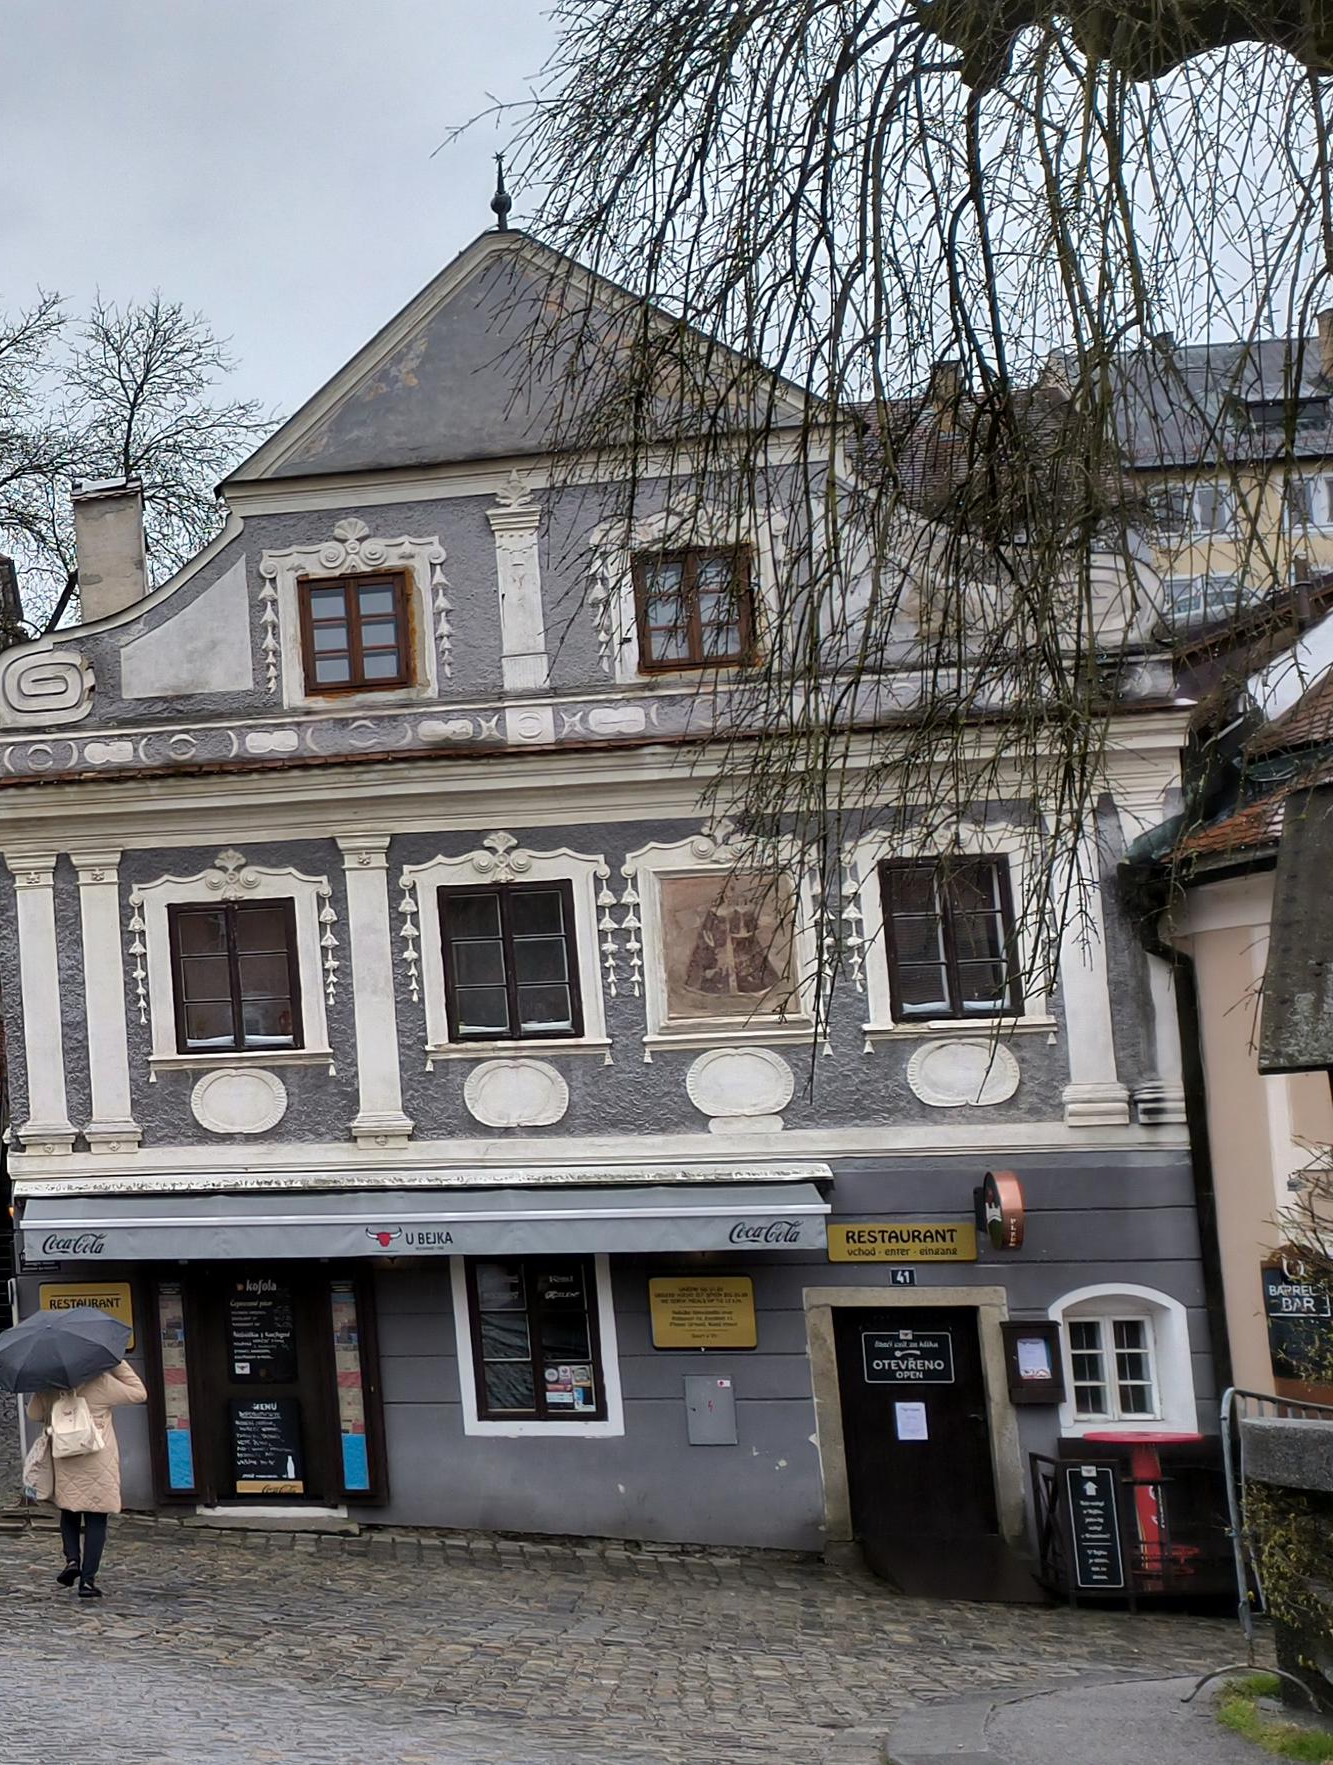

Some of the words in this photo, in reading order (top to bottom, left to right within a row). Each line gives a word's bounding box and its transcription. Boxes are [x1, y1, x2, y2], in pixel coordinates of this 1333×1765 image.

[405, 1231, 415, 1246] U
[418, 1230, 454, 1245] BEJKA
[728, 1219, 804, 1244] Coca-Cola
[845, 1228, 958, 1245] RESTAURANT
[42, 1232, 108, 1255] Coca-Cola
[847, 1247, 876, 1257] vchod
[884, 1247, 910, 1256] enter
[919, 1246, 958, 1256] eingang
[896, 1270, 910, 1284] 41
[49, 1297, 122, 1311] RESTAURANT
[1282, 1297, 1317, 1312] BAR
[873, 1357, 944, 1370] OTEVŘENO
[896, 1371, 923, 1380] OPEN
